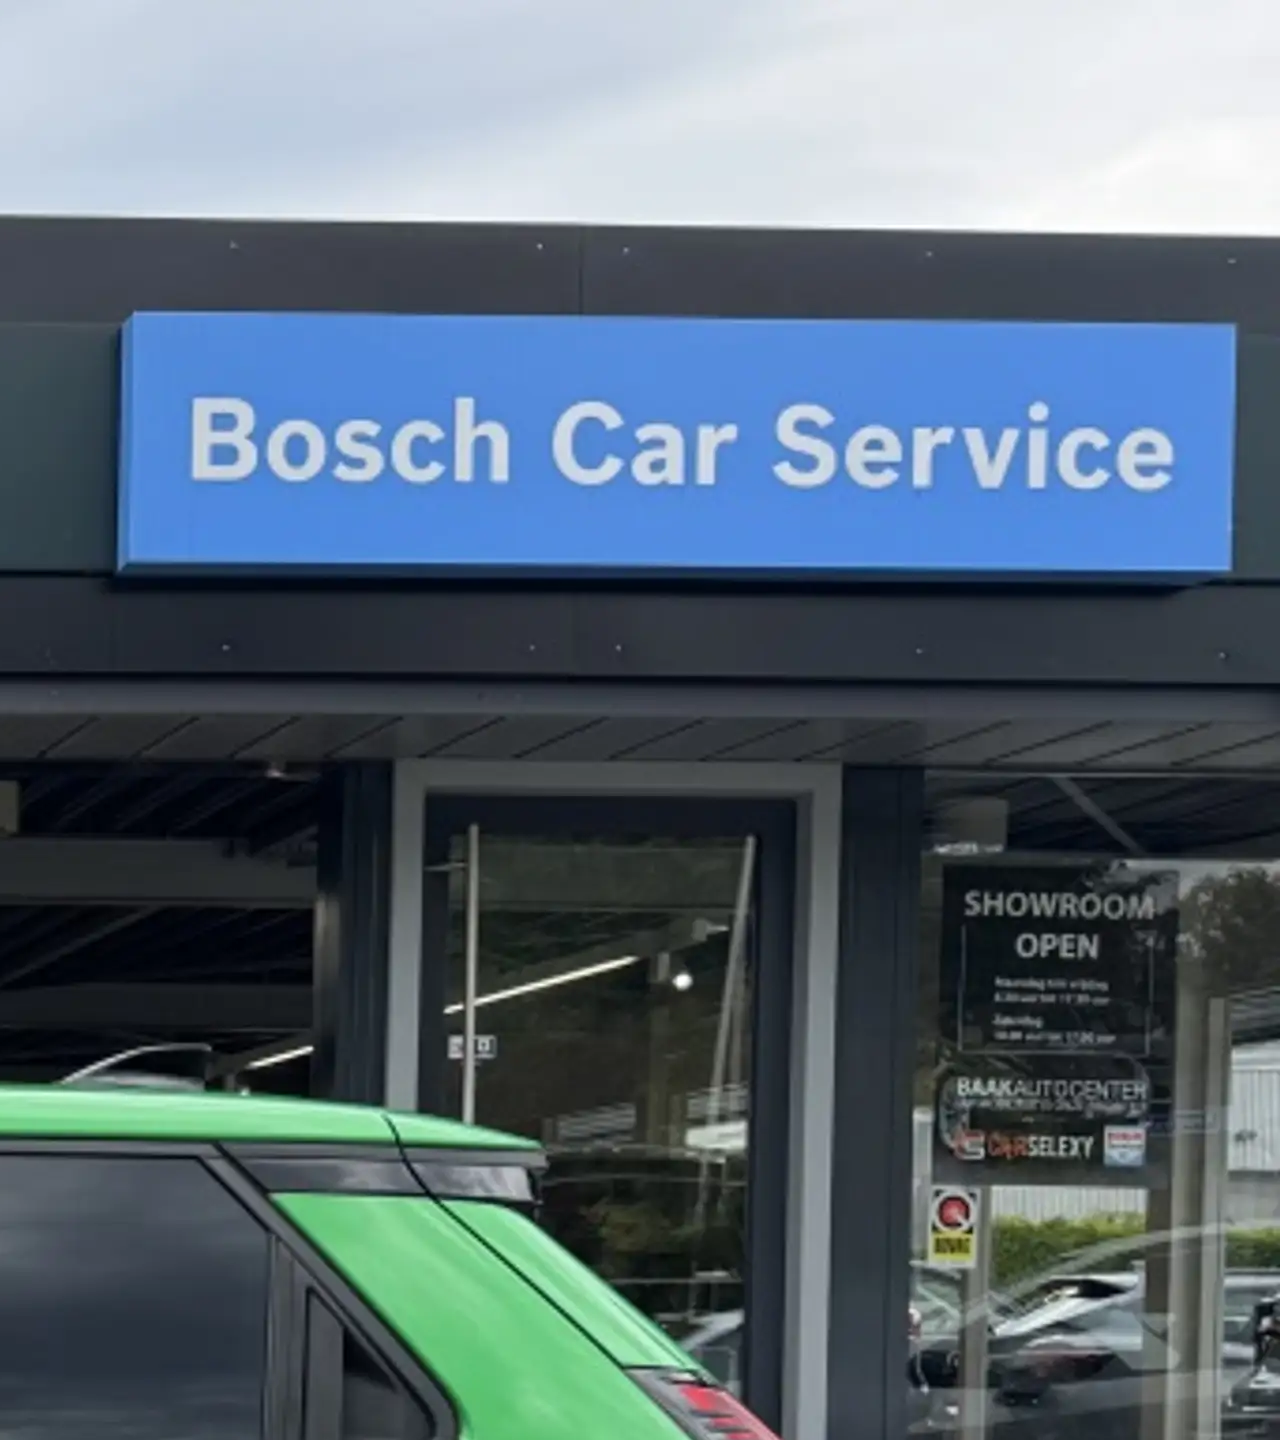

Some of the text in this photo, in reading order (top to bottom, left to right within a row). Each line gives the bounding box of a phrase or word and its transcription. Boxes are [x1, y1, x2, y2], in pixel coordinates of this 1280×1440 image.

[190, 396, 1175, 492] Bosch Car Service
[964, 890, 1154, 920] SHOWROOM
[1016, 933, 1100, 960] OPEN
